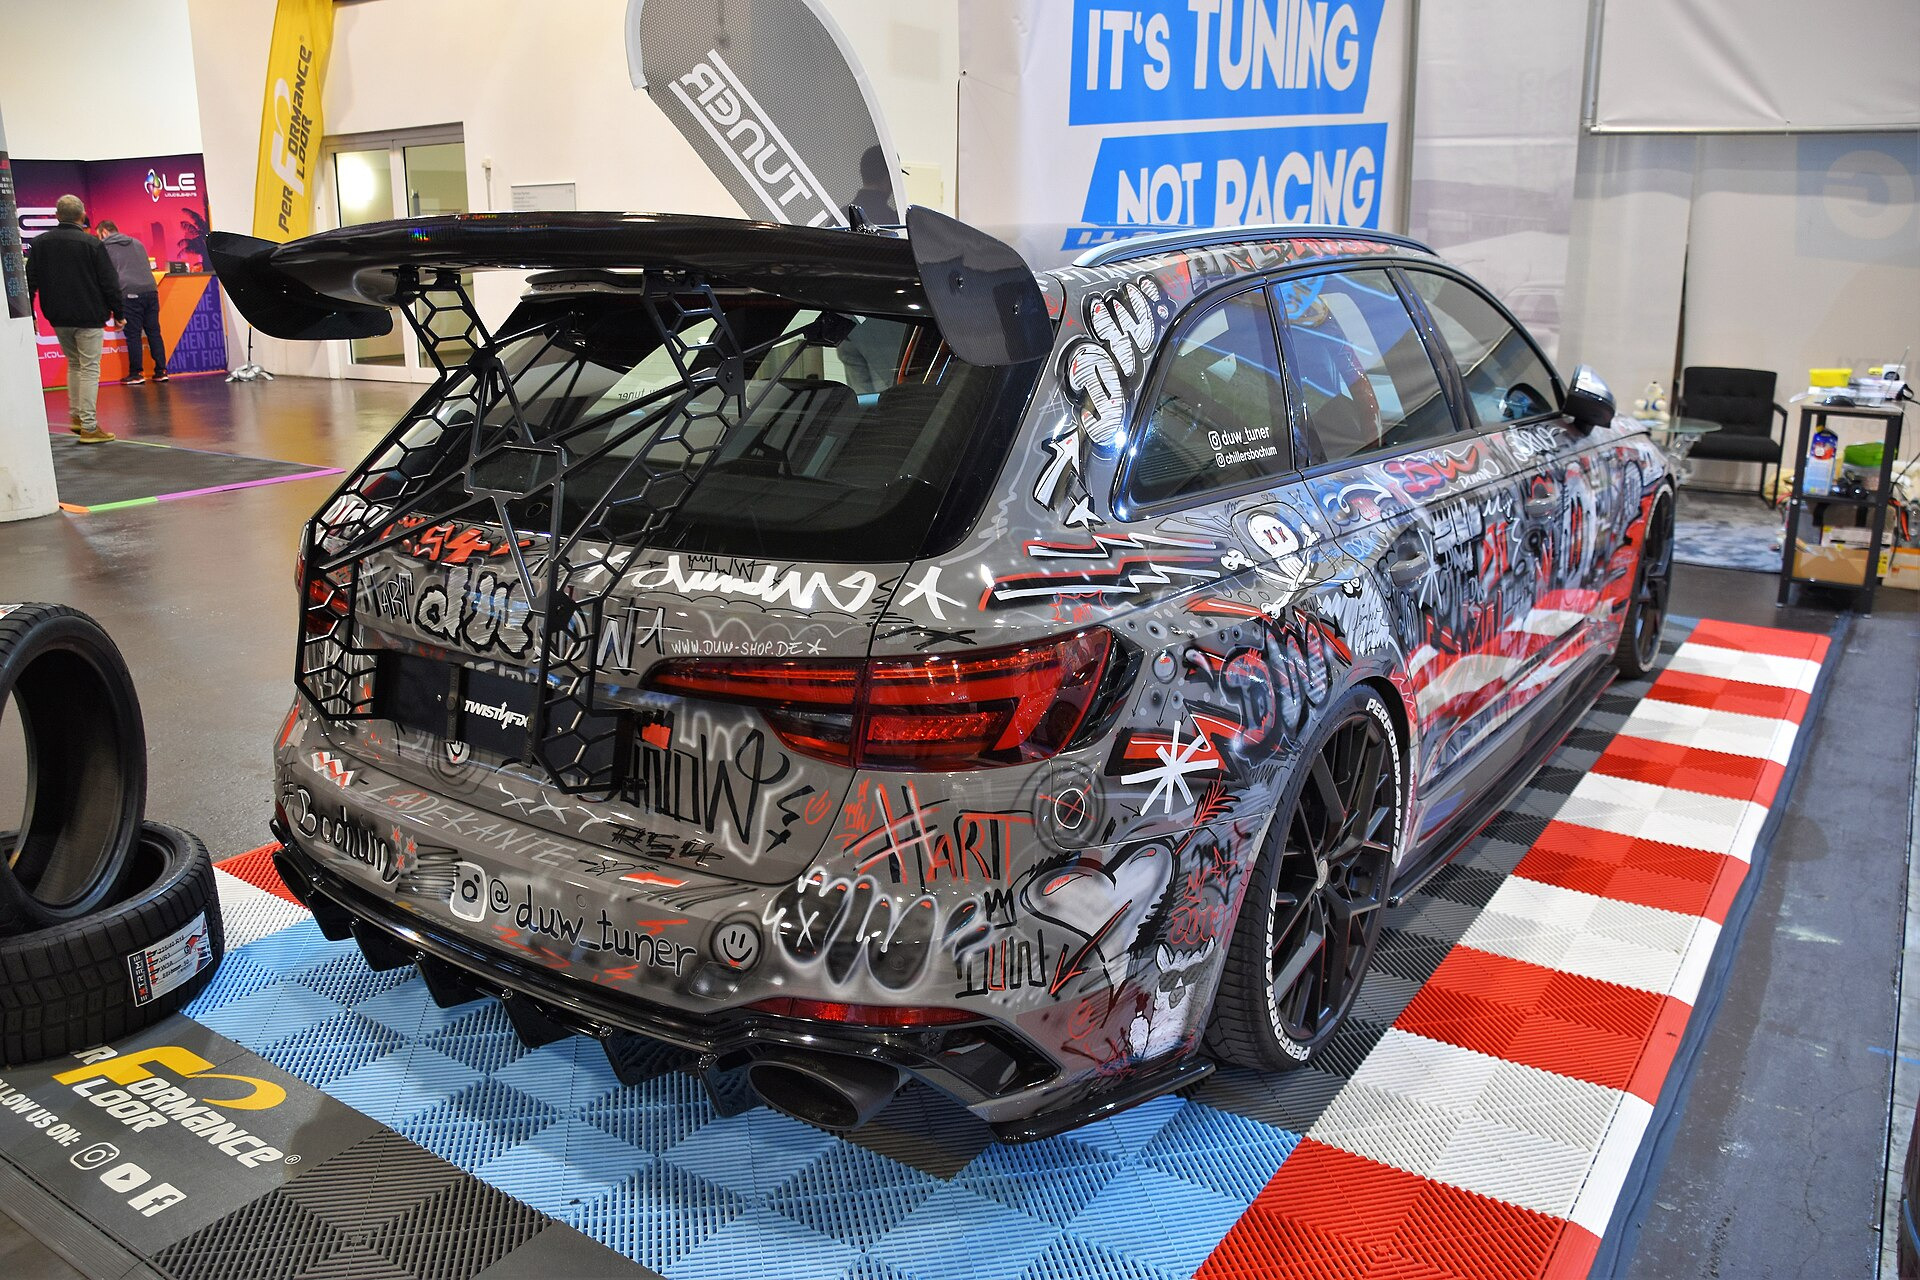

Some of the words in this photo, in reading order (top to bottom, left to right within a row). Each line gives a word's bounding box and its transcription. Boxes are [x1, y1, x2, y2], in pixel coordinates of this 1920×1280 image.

[1087, 9, 1170, 91] IT'S
[1188, 0, 1359, 91] TUNING
[1117, 162, 1202, 225] NOT
[1214, 146, 1375, 228] RACING
[1221, 426, 1270, 446] duw_tuner
[1225, 445, 1278, 466] chillersbochum
[671, 639, 804, 658] WWW.DUW-SHOP.DE
[1366, 698, 1401, 868] PERFORMANCE
[360, 782, 578, 868] LADEKANTE
[1263, 889, 1312, 1063] PERFORMANCE
[25, 1110, 59, 1129] US
[46, 1123, 82, 1147] ON:
